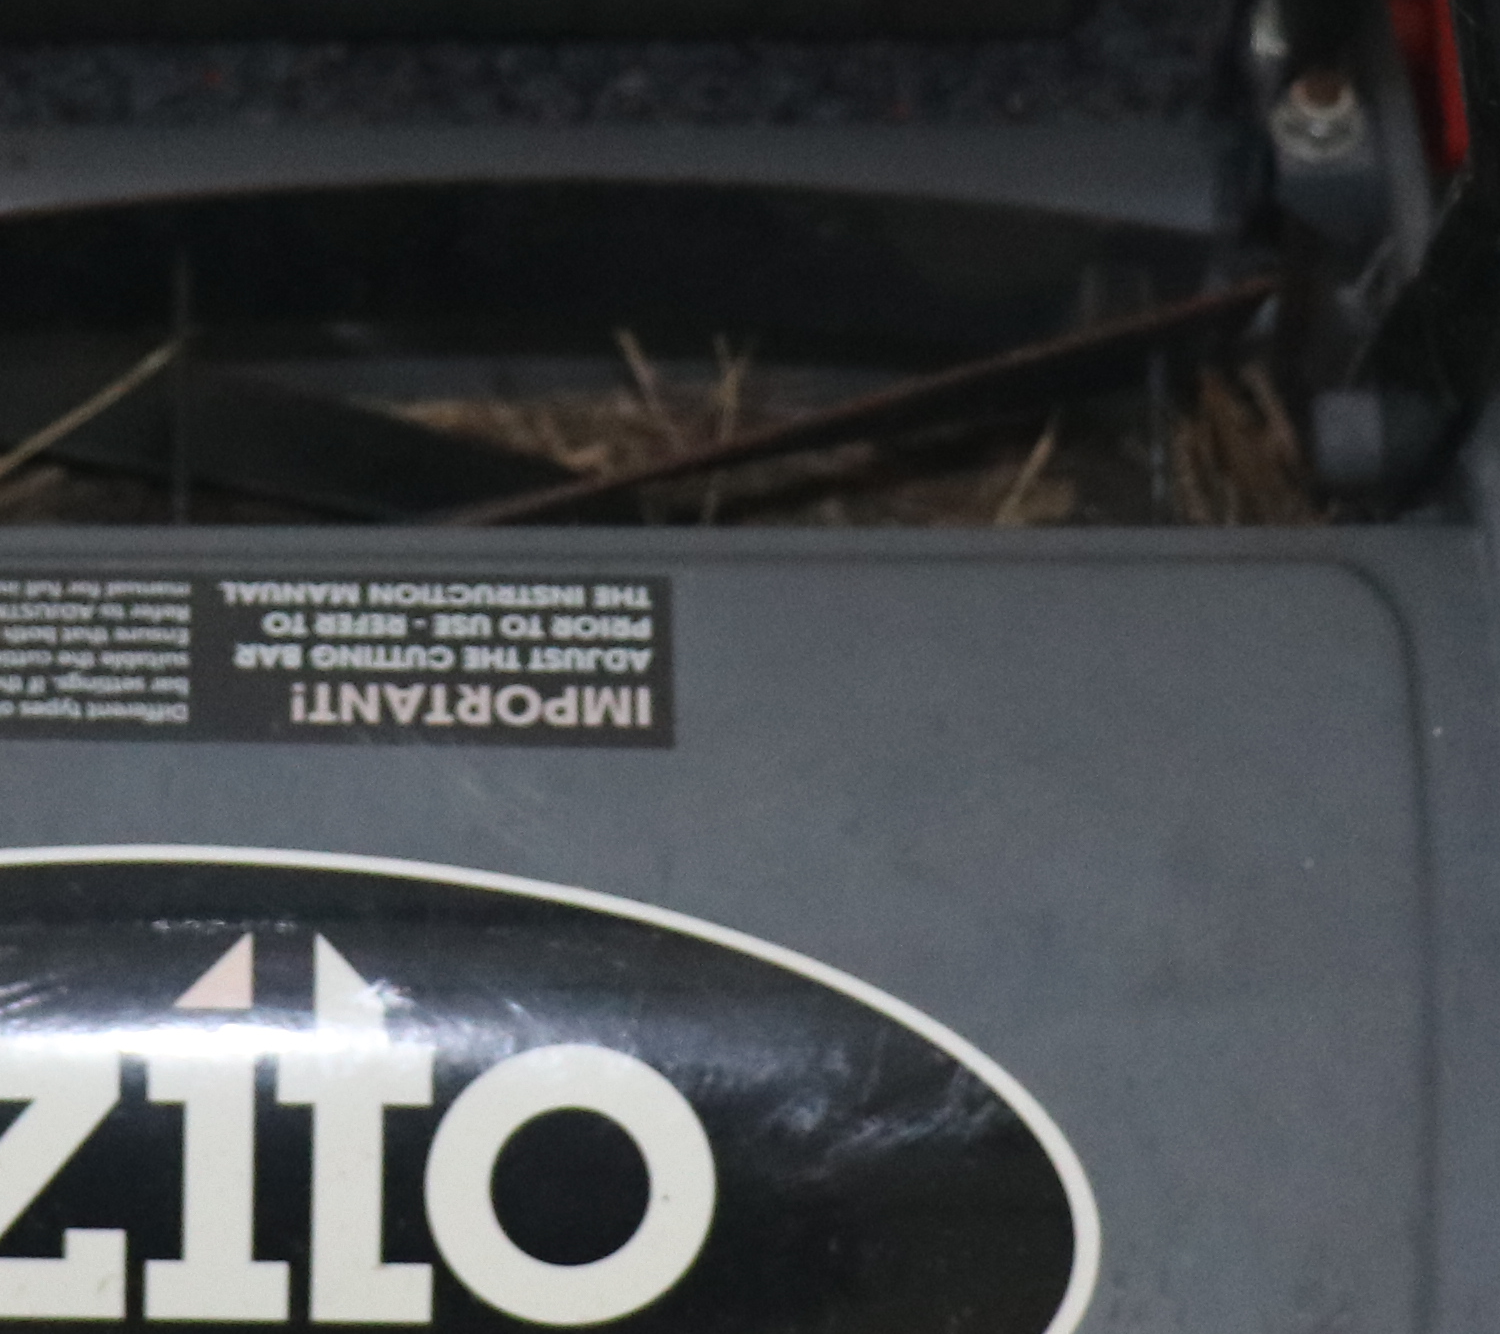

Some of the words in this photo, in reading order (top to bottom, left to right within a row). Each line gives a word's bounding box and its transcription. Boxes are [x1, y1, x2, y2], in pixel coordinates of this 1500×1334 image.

[217, 581, 361, 606] MANUAL
[369, 583, 585, 607] INSTRUCTION
[592, 585, 651, 607] THE
[99, 603, 126, 619] to
[261, 610, 307, 637] TO
[314, 613, 407, 638] REFER
[433, 613, 492, 638] USE
[501, 613, 543, 639] TO
[552, 614, 652, 640] PRIOR
[233, 643, 302, 669] BAR
[312, 643, 456, 670] CUTTING
[464, 645, 520, 671] THE
[531, 645, 652, 672] ADJUST
[19, 697, 82, 719] types
[86, 701, 189, 723] Different
[290, 682, 652, 728] IMPORTANT!
